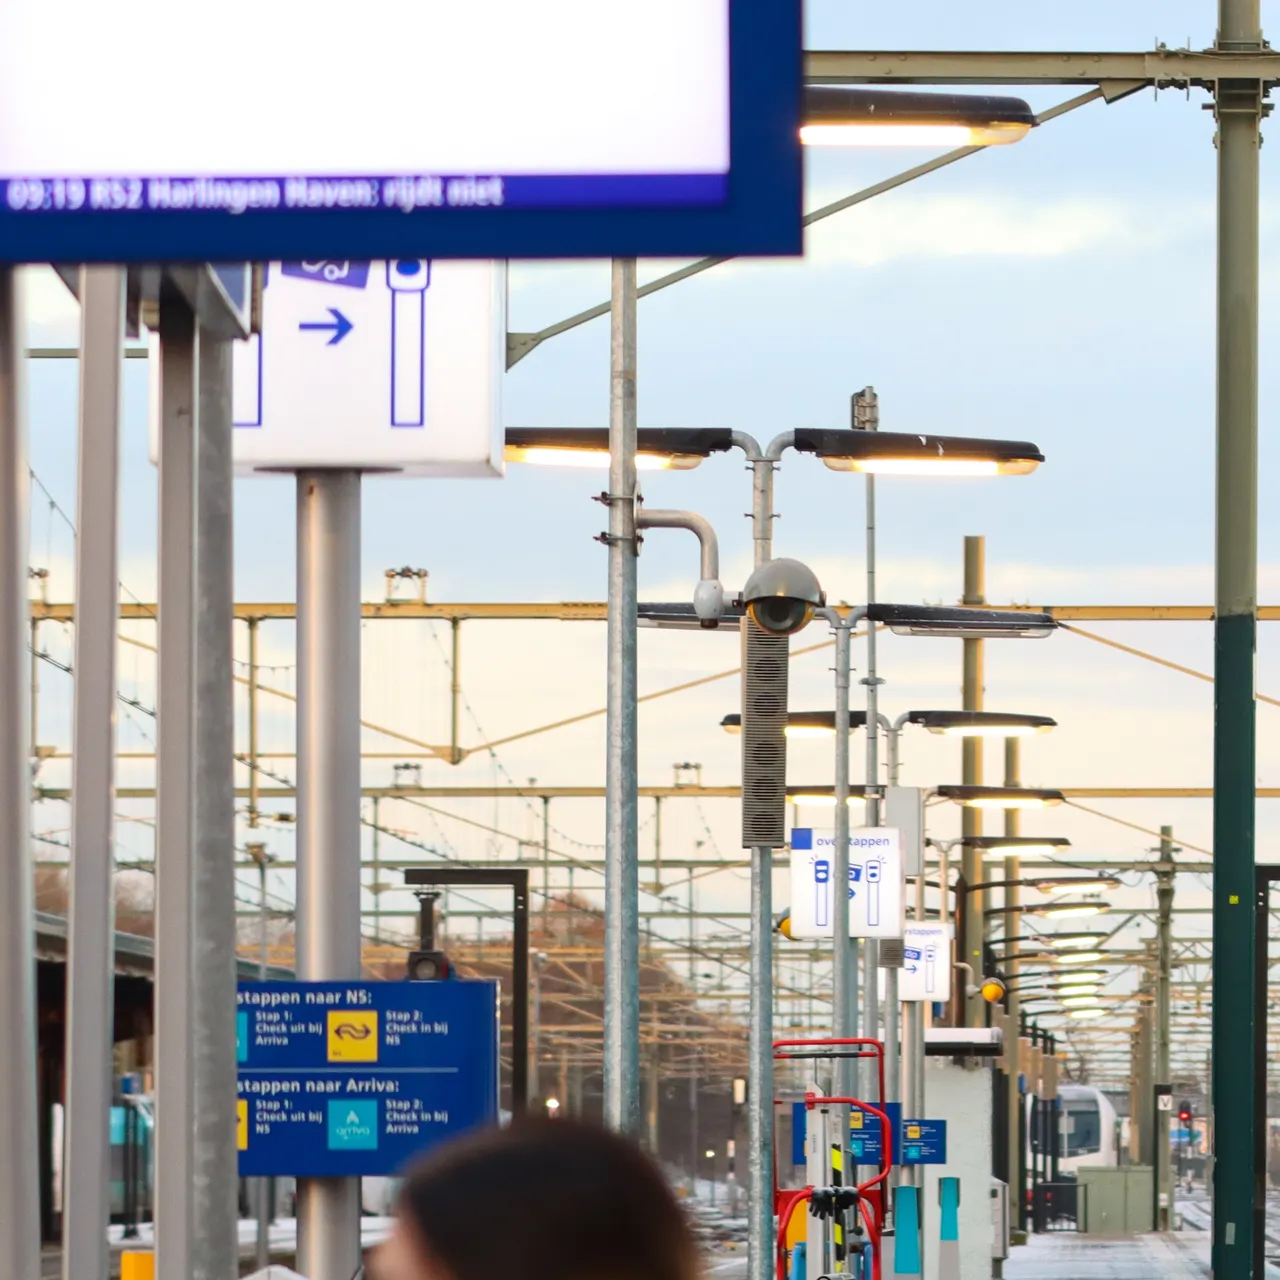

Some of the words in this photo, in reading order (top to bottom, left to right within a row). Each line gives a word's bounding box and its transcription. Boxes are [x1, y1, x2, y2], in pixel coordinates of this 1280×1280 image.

[7, 177, 86, 210] 09:19
[149, 176, 280, 215] Harlingen
[284, 176, 379, 208] Haven:
[382, 175, 444, 214] rijdt
[447, 174, 503, 206] niet
[816, 837, 890, 848] ovetappen
[237, 990, 300, 1007] stappen
[305, 992, 341, 1004] naar
[346, 989, 372, 1004] NS:
[255, 1010, 280, 1022] Stap
[385, 1010, 410, 1022] Stap
[255, 1022, 288, 1033] Check
[290, 1022, 305, 1033] uit
[308, 1022, 323, 1036] bij
[385, 1022, 418, 1034] Check
[421, 1022, 432, 1033] in
[434, 1022, 448, 1035] bij
[255, 1034, 289, 1046] Arriva
[237, 1079, 300, 1096] stappen
[305, 1081, 341, 1093] naar
[346, 1077, 399, 1093] Arriva:
[255, 1099, 280, 1111] Stap
[385, 1098, 411, 1111] Stap
[255, 1111, 288, 1122] Check
[290, 1111, 305, 1122] uit
[308, 1111, 323, 1125] bij
[385, 1111, 418, 1122] Check
[421, 1111, 432, 1122] in
[434, 1111, 448, 1124] bij
[385, 1123, 419, 1134] Arriva
